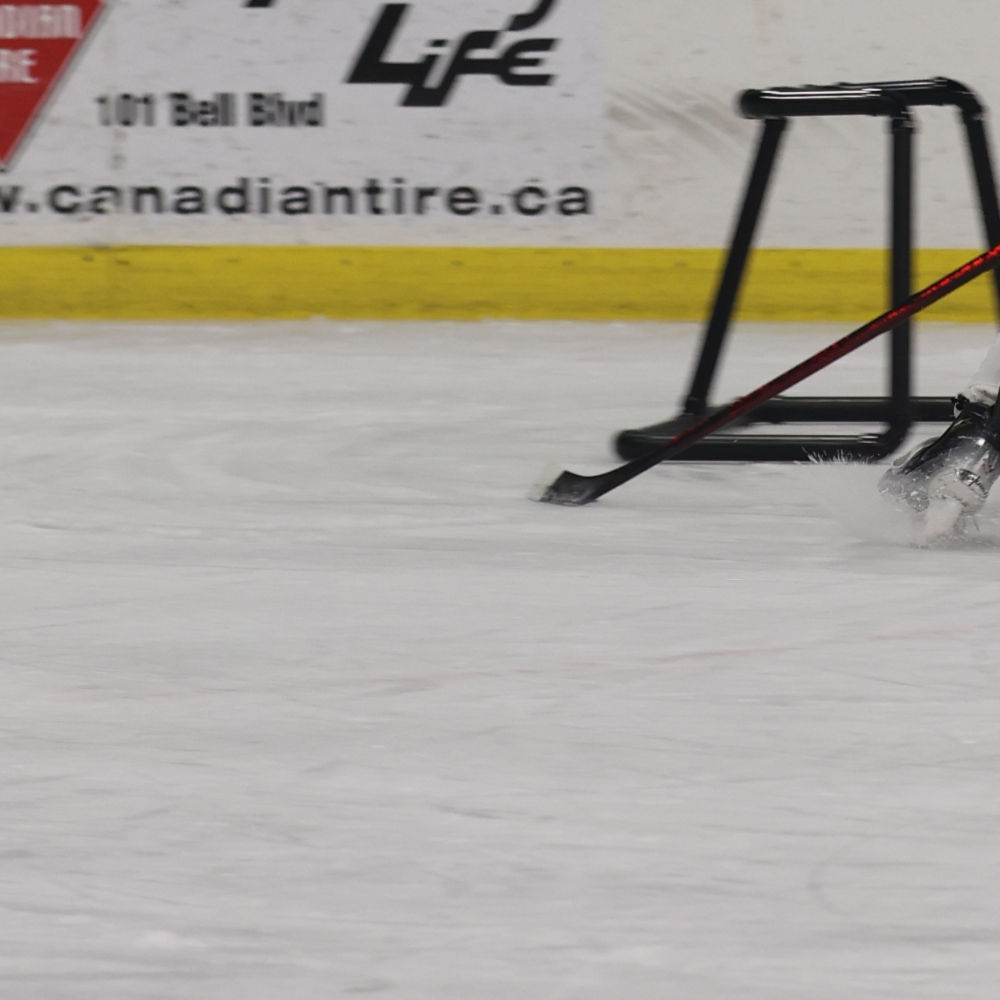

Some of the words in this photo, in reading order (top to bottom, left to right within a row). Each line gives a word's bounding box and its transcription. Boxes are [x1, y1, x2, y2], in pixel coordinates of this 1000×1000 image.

[97, 93, 155, 127] 101
[166, 93, 236, 127] Bell
[247, 93, 325, 127] Blvd
